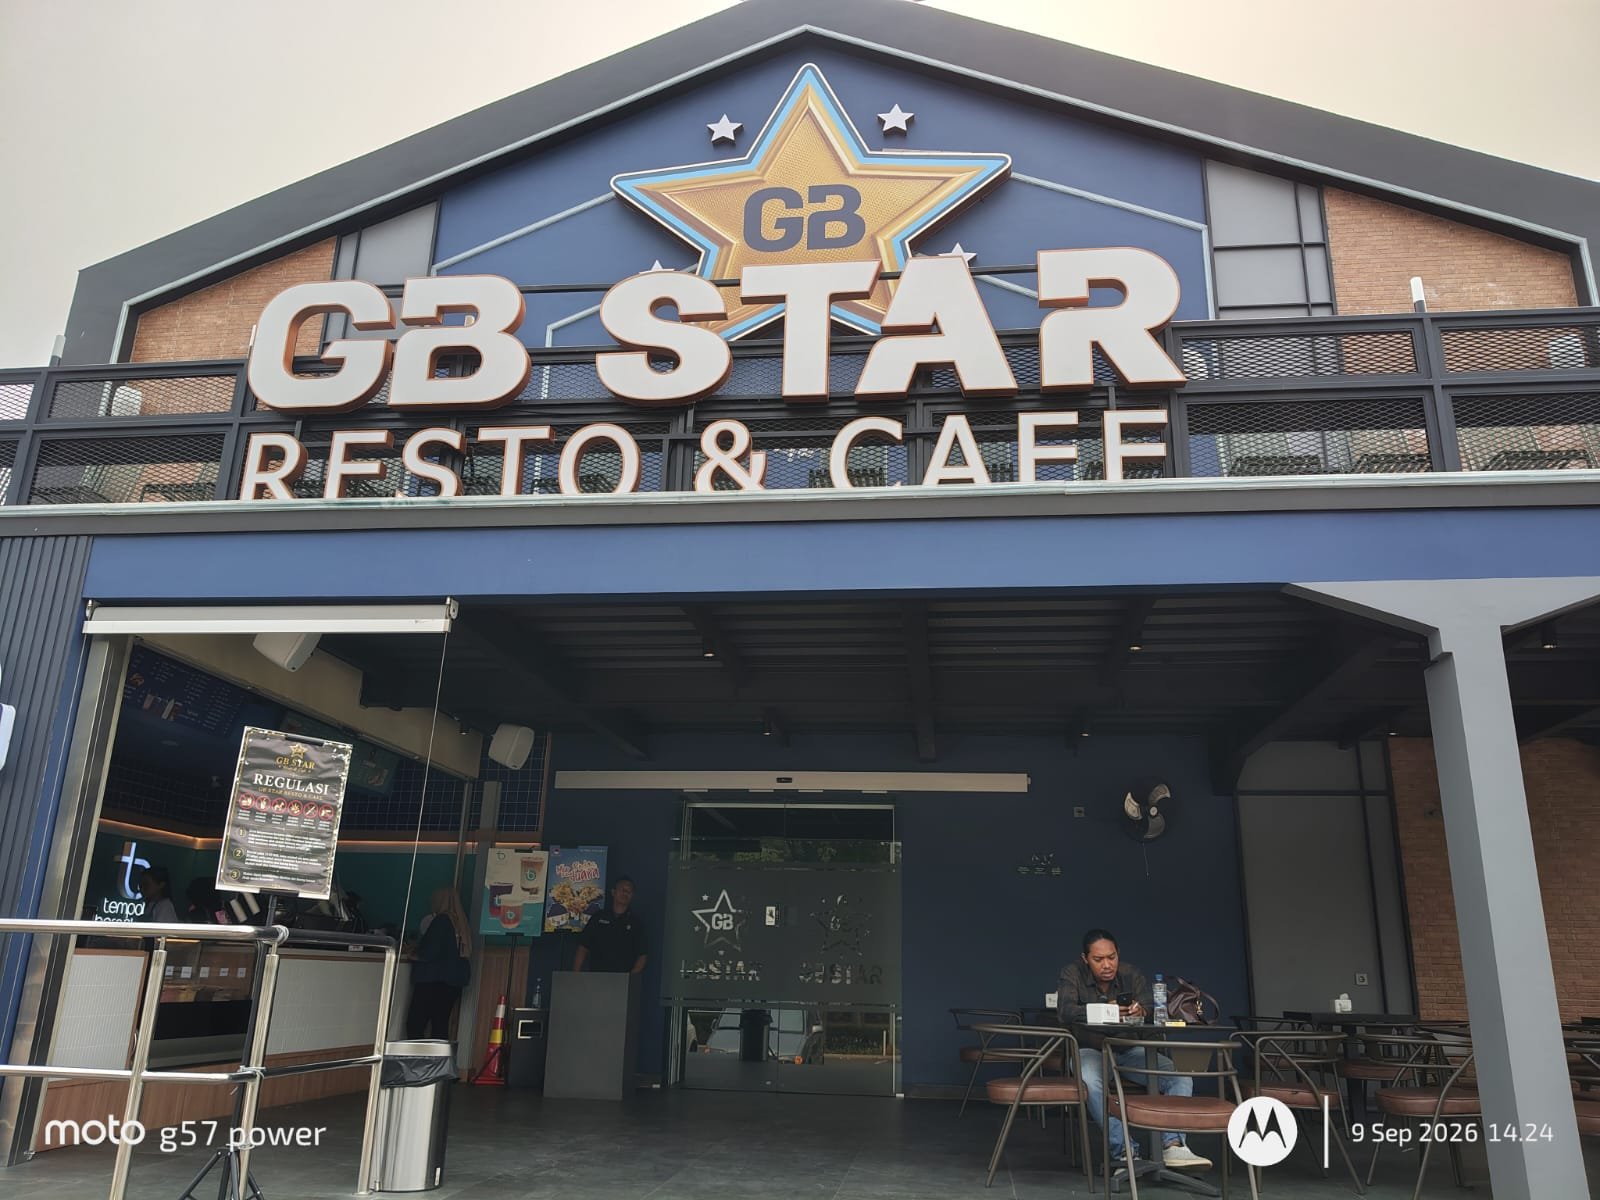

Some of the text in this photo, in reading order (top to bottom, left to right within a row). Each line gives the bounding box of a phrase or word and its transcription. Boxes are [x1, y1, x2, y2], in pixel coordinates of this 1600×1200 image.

[742, 184, 866, 252] GB
[248, 247, 1187, 411] GB STAR
[240, 410, 1168, 500] RESTO & CAFE
[253, 773, 330, 795] REGULASI
[711, 913, 734, 930] GB
